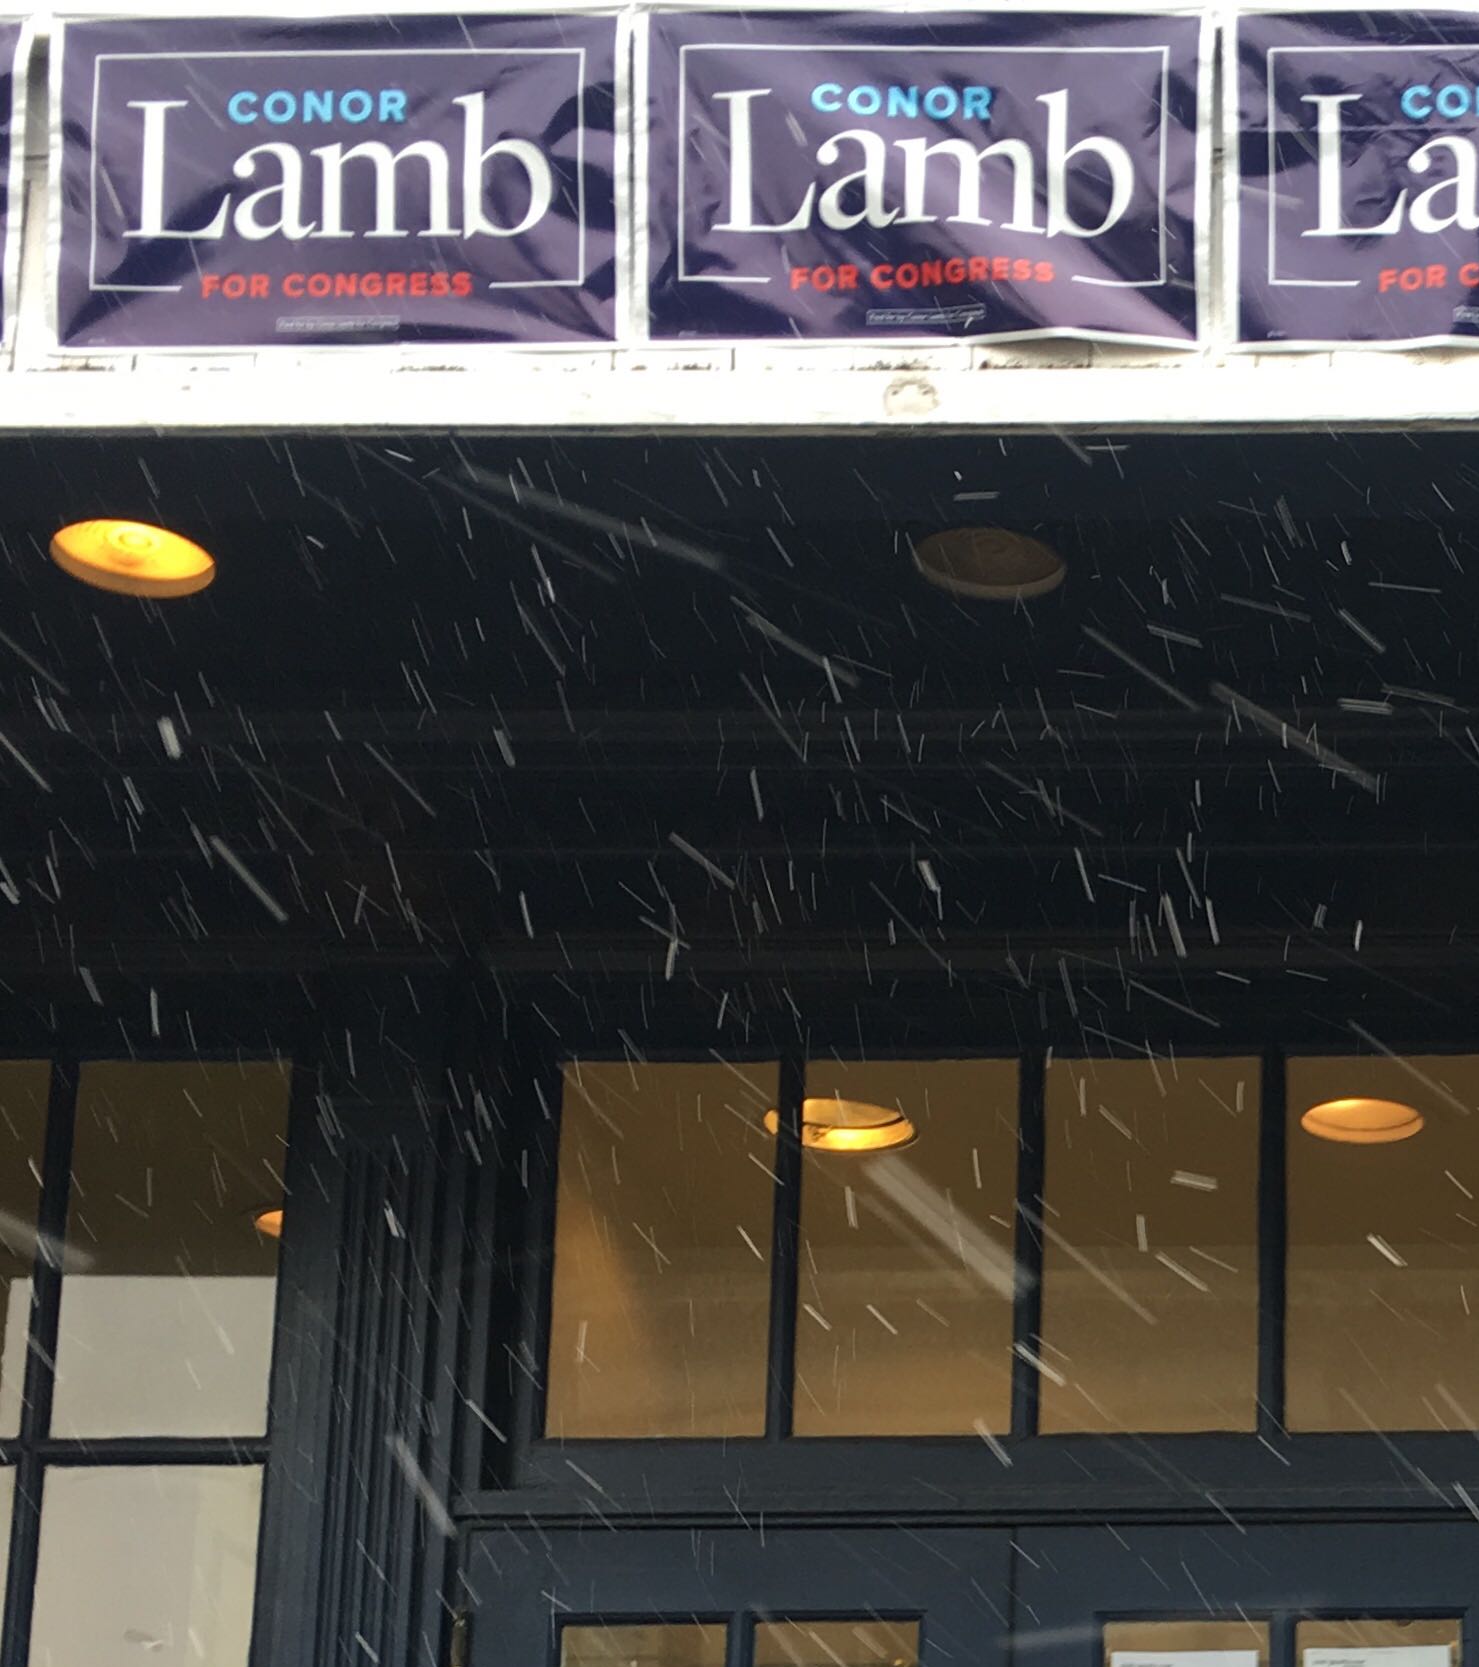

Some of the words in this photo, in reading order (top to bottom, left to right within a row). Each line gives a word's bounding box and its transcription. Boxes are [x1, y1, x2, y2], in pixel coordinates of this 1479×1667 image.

[228, 90, 406, 124] CONOR
[812, 84, 992, 120] CONOR
[123, 92, 551, 240] Lamb
[712, 84, 1134, 238] Lamb
[201, 273, 270, 299] FOR
[282, 272, 472, 298] CONGRESS
[790, 264, 859, 292] FOR
[870, 256, 1055, 290] CONGRESS
[1379, 264, 1447, 292] FOR
